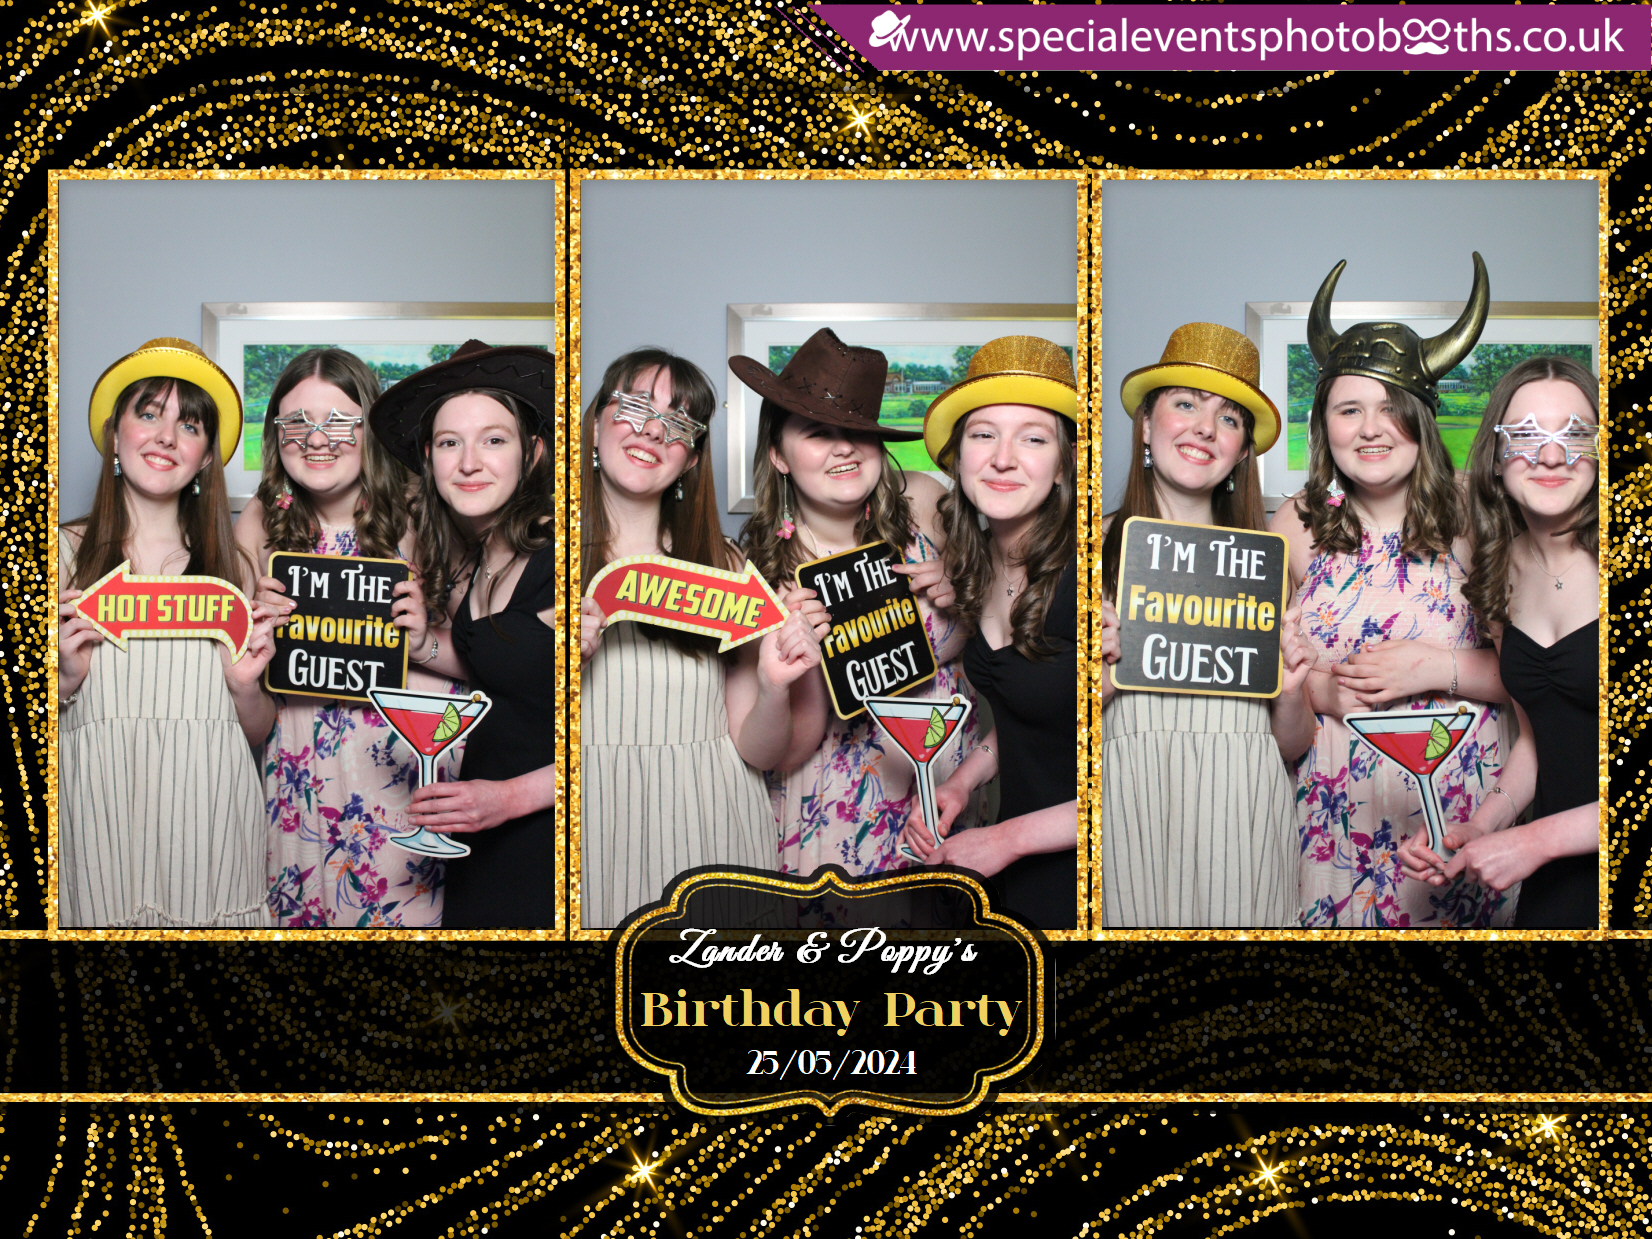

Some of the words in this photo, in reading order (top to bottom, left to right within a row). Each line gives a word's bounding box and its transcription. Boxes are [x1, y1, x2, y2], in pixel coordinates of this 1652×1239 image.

[814, 570, 854, 607] I'M
[853, 552, 897, 593] THE
[1147, 533, 1196, 573] I'M
[1209, 535, 1266, 581] THE
[288, 565, 330, 599] I'M
[340, 563, 392, 604] THE
[615, 569, 766, 629] AWESOME
[97, 594, 151, 623] HOT
[157, 594, 235, 622] STUFF
[1128, 584, 1275, 632] Favourite
[288, 648, 385, 692] GUEST
[845, 640, 920, 701] GUEST
[1141, 633, 1259, 686] GUEST
